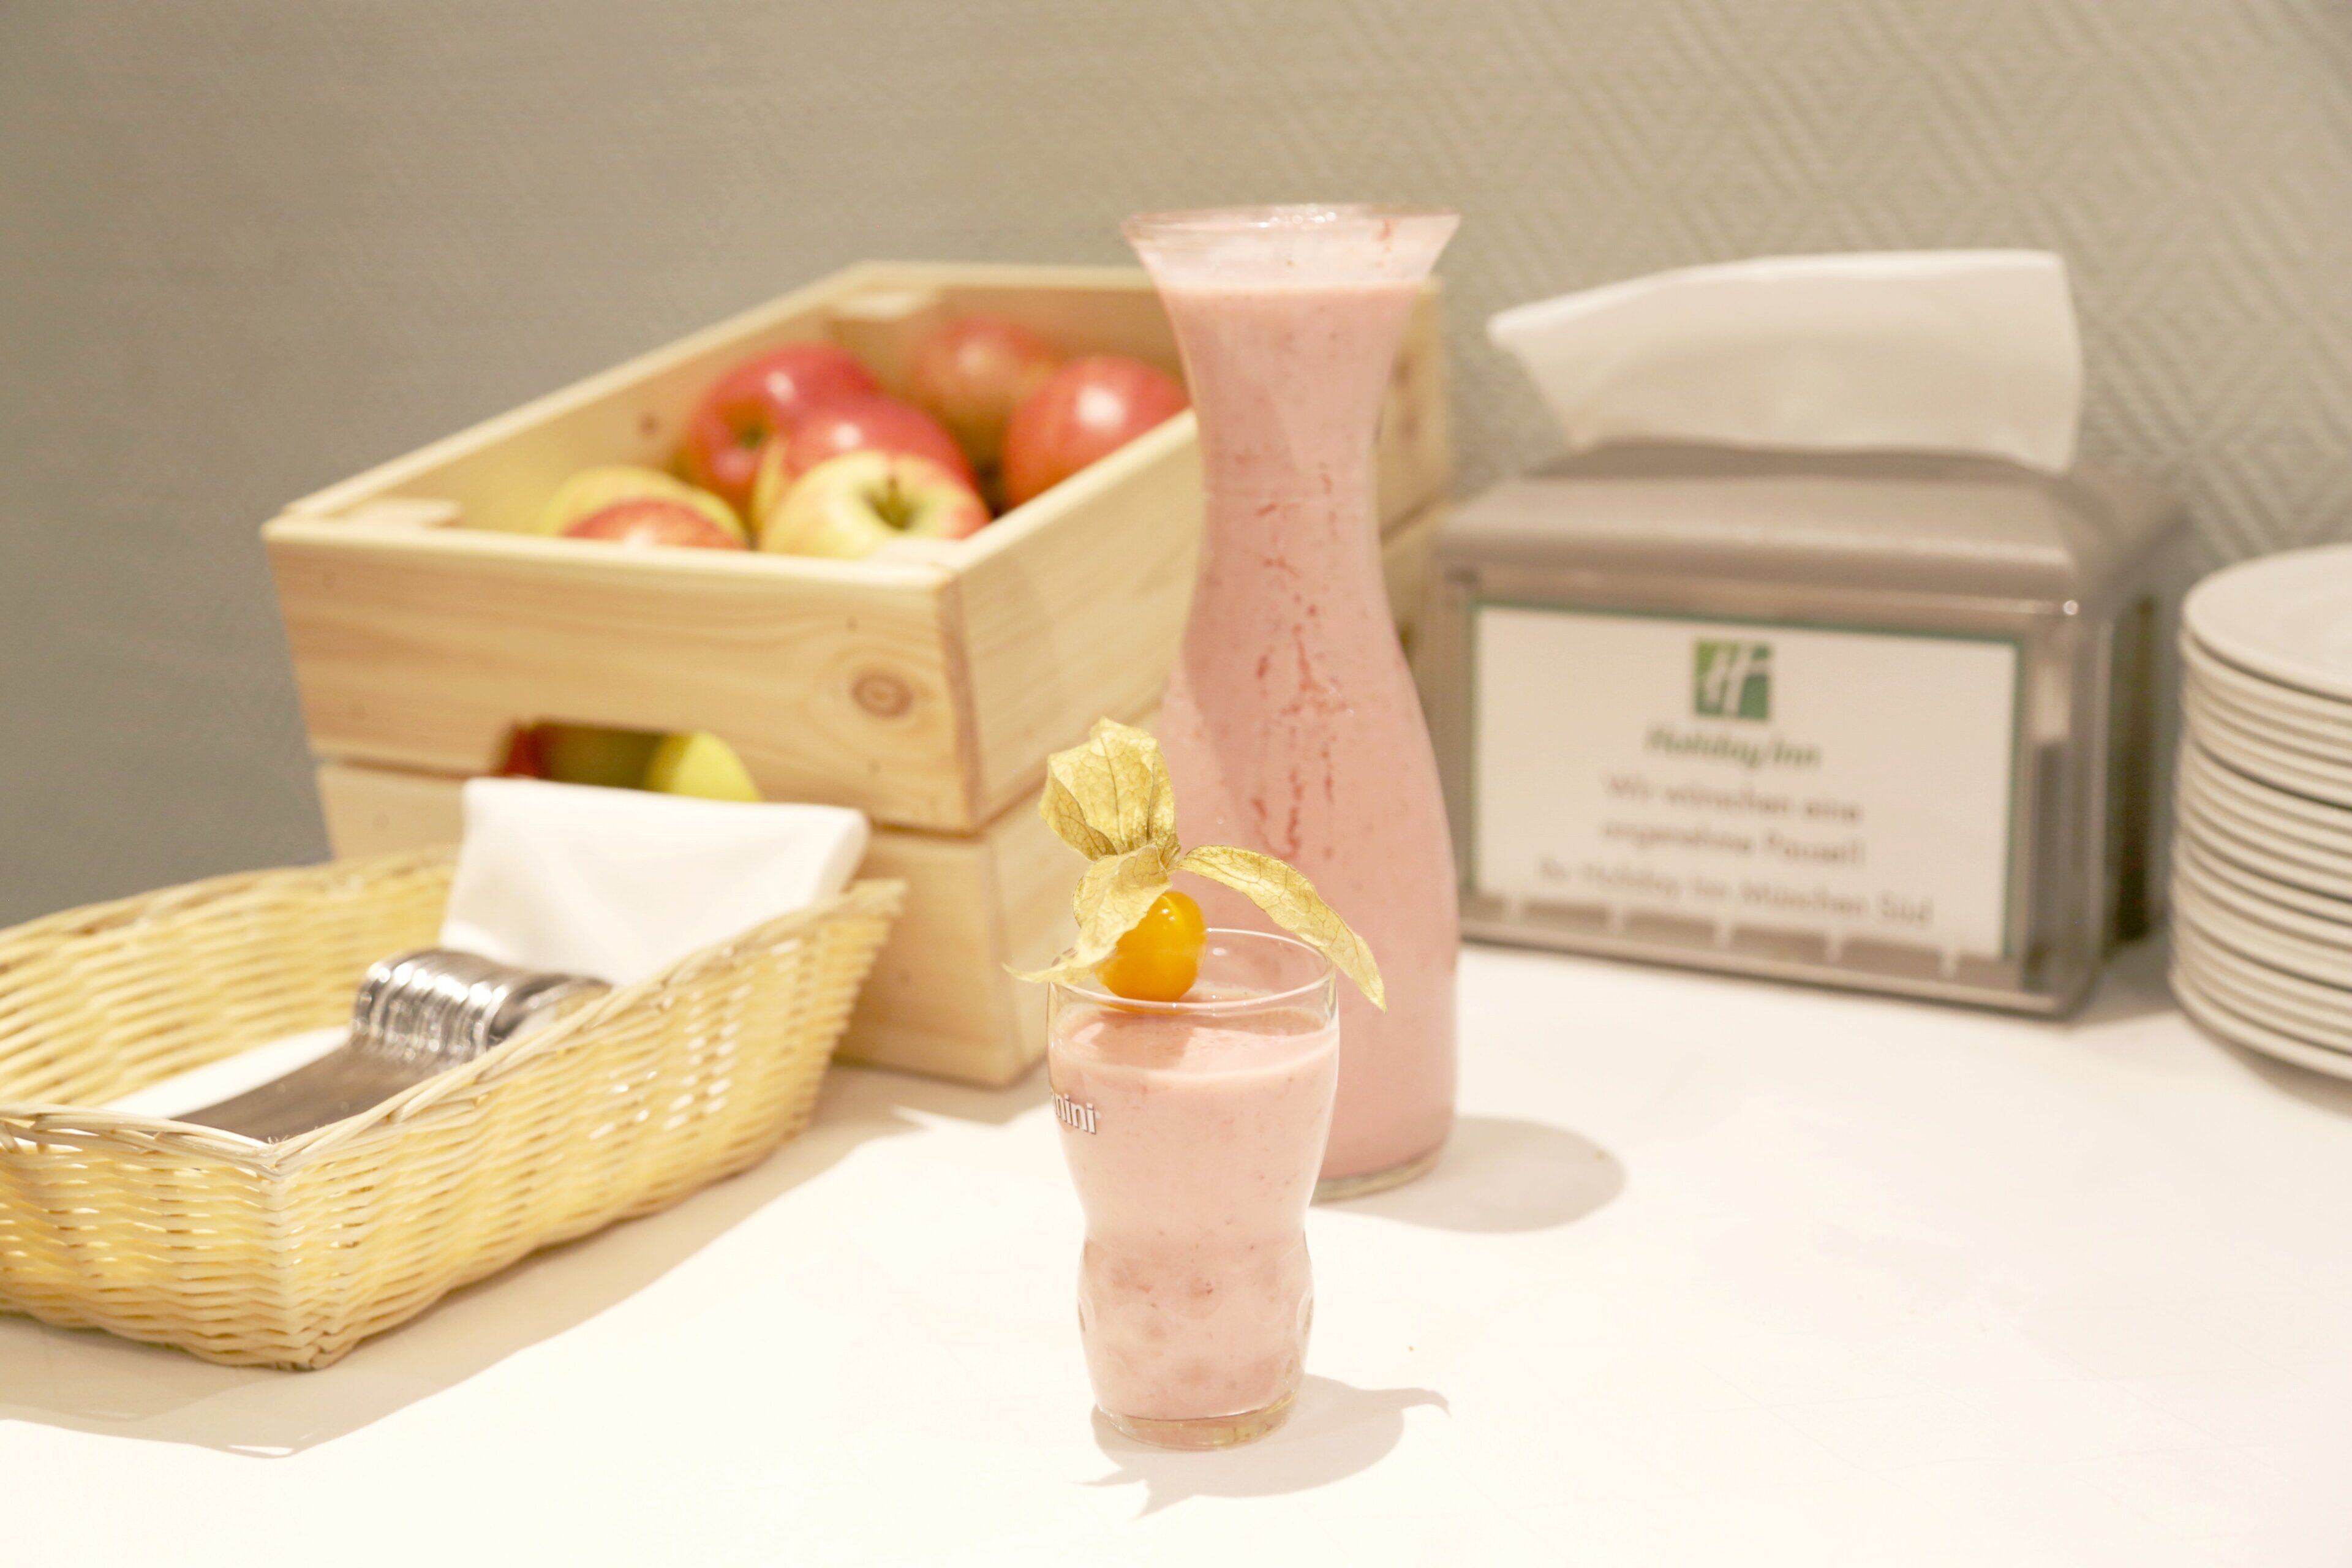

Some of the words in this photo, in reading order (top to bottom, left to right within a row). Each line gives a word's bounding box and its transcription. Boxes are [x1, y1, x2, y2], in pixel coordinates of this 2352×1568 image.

[1643, 726, 1765, 769] Holiday
[1769, 733, 1822, 771] Inn
[1600, 772, 1653, 802] Wir
[1800, 795, 1863, 824] eine
